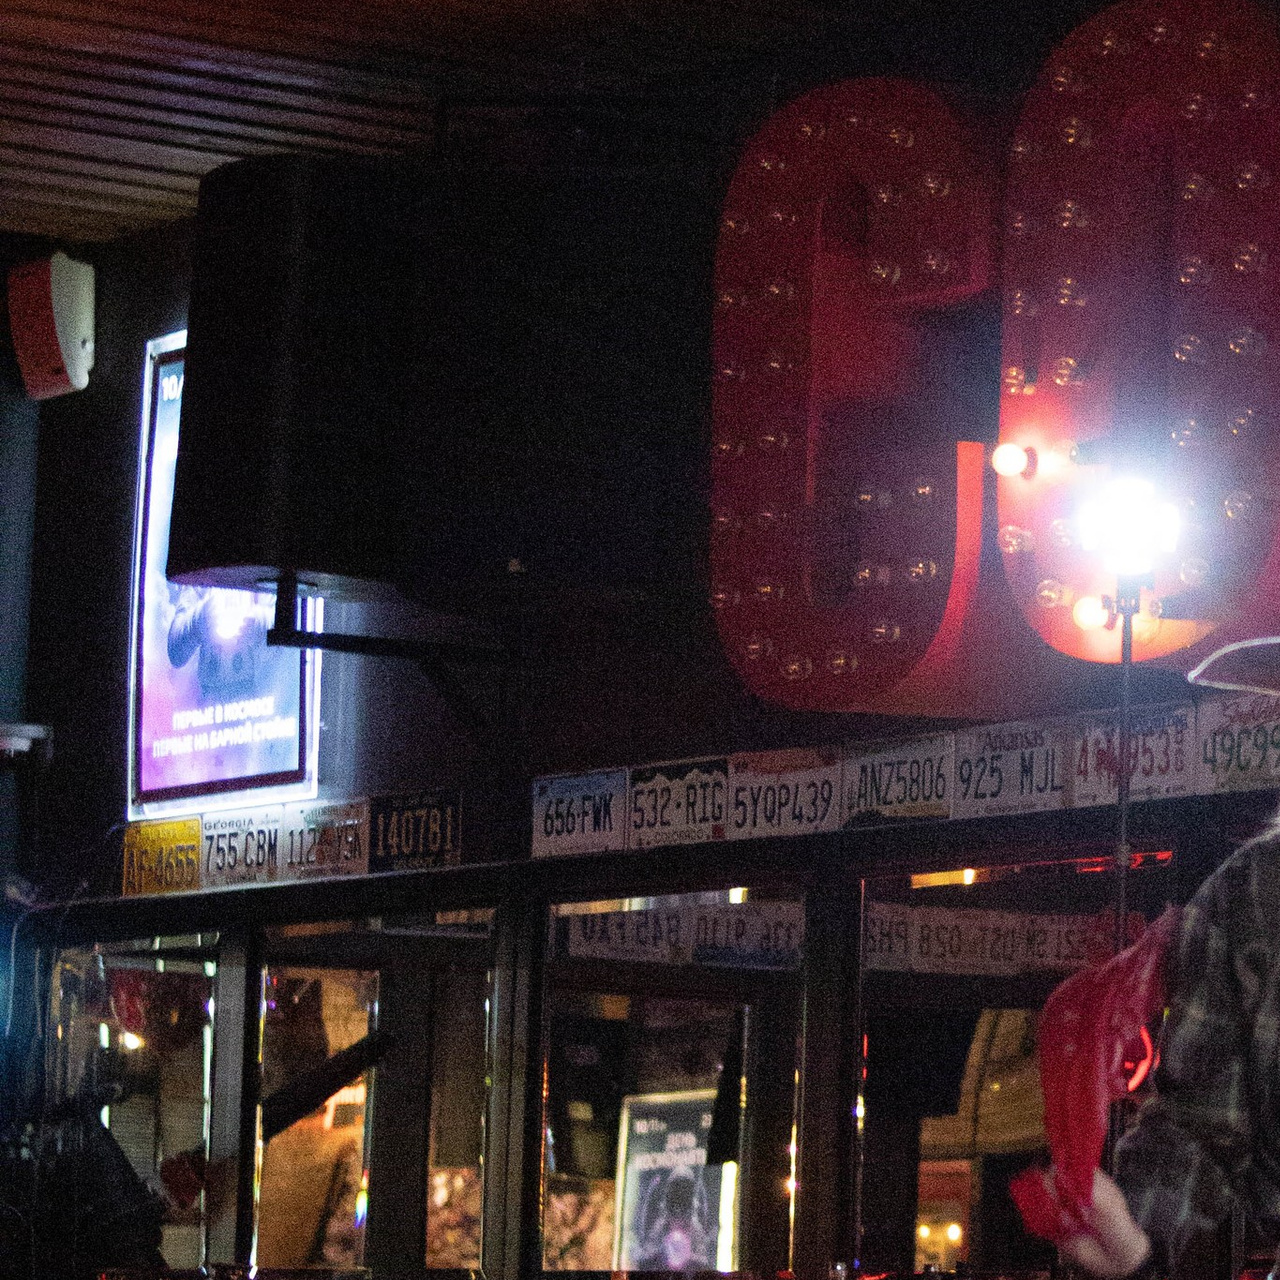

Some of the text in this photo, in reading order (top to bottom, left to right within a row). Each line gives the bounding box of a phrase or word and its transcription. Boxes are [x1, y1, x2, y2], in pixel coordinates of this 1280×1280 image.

[958, 753, 1004, 800] 925
[1019, 749, 1065, 795] MJL
[203, 818, 255, 832] GEORGIA
[204, 828, 279, 873] 755 CBM
